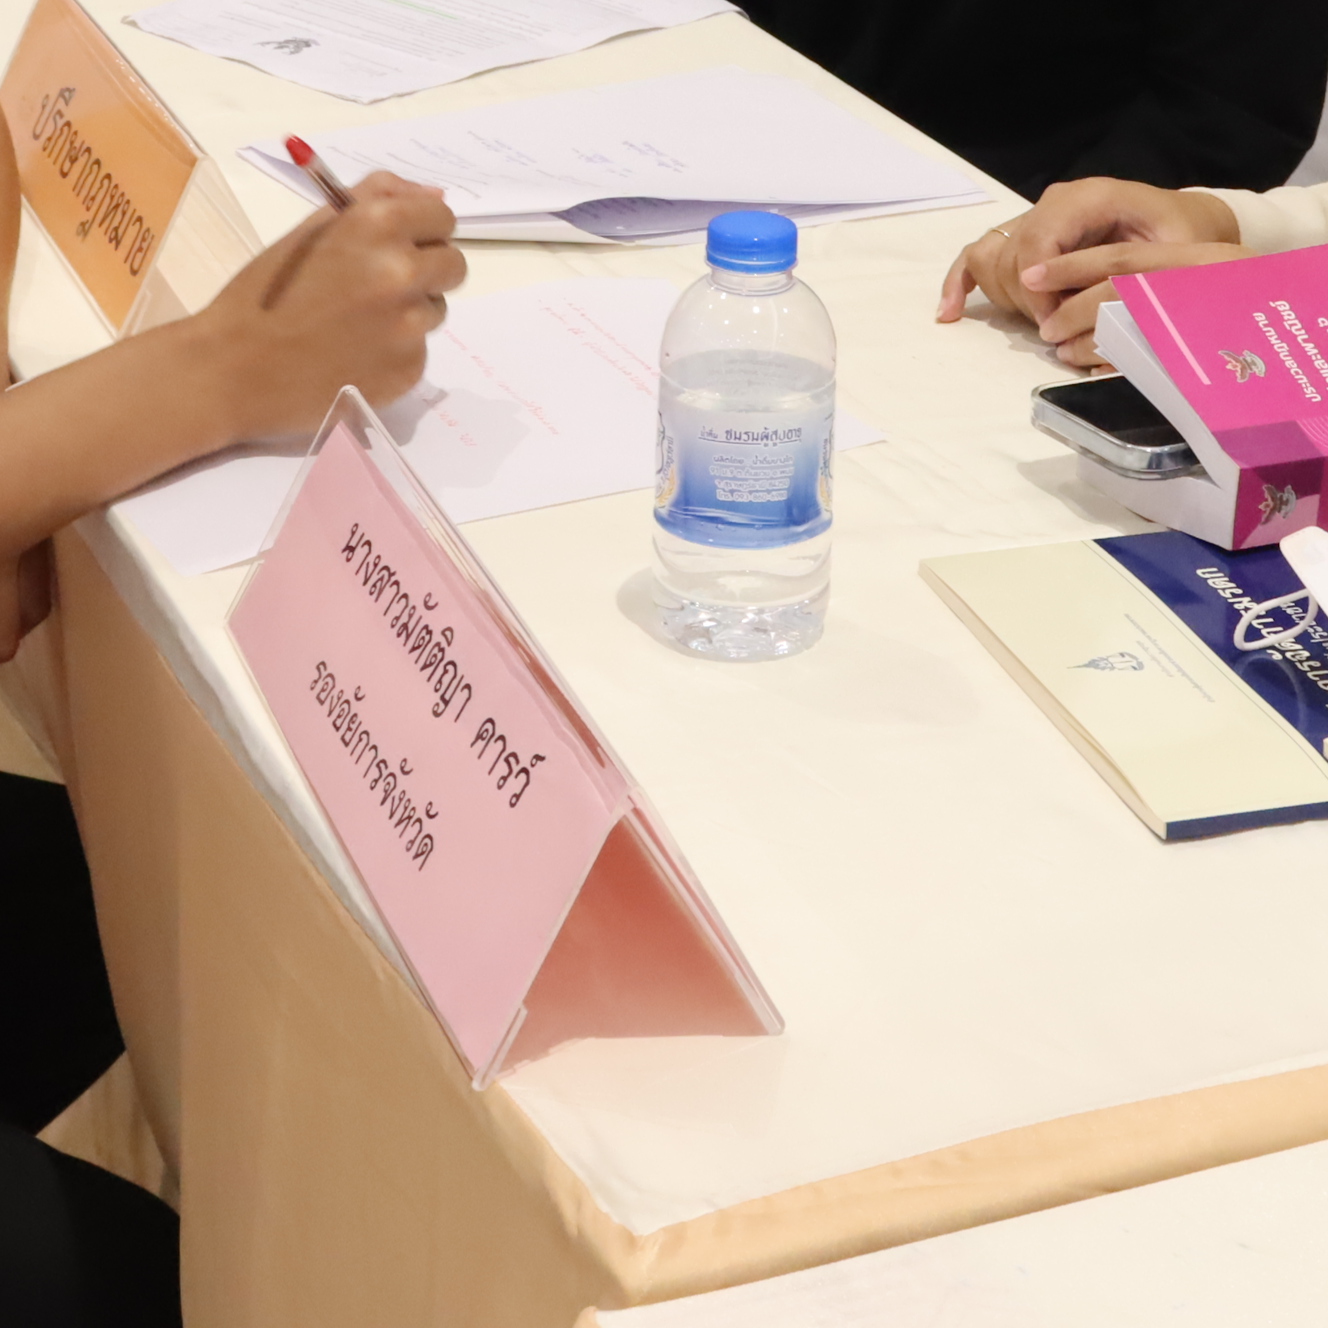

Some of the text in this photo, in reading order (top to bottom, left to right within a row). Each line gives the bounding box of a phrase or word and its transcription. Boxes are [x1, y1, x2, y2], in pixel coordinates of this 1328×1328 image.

[1252, 311, 1322, 403] ประมวลกฎหมาย
[724, 427, 803, 448] ชมรมผู้สูงอายุ
[341, 522, 473, 723] นางสาวมัตติญา
[309, 659, 439, 872] รองอัยการจังหวัด
